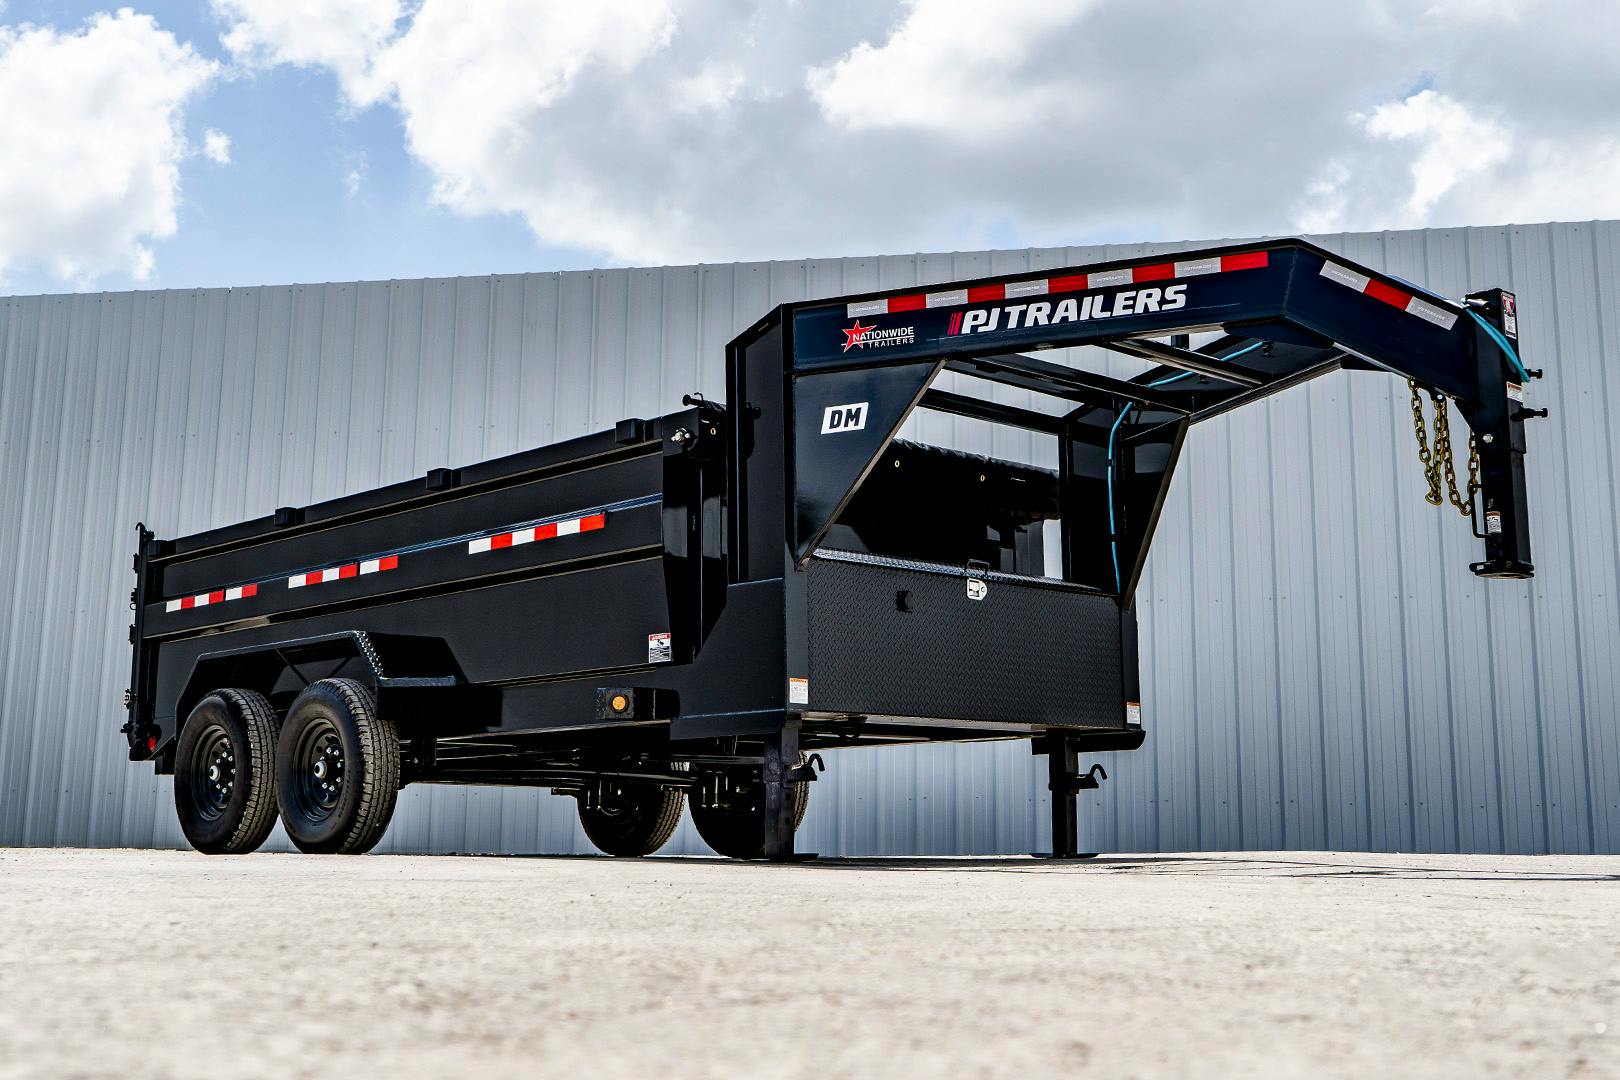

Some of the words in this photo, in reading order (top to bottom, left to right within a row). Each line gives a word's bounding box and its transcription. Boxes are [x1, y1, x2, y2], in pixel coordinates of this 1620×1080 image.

[961, 307, 1001, 334] PJ
[1004, 284, 1188, 330] TRAILERS
[852, 326, 914, 341] NATIONWIDE
[868, 338, 914, 348] TRAILERS
[829, 407, 862, 429] DM
